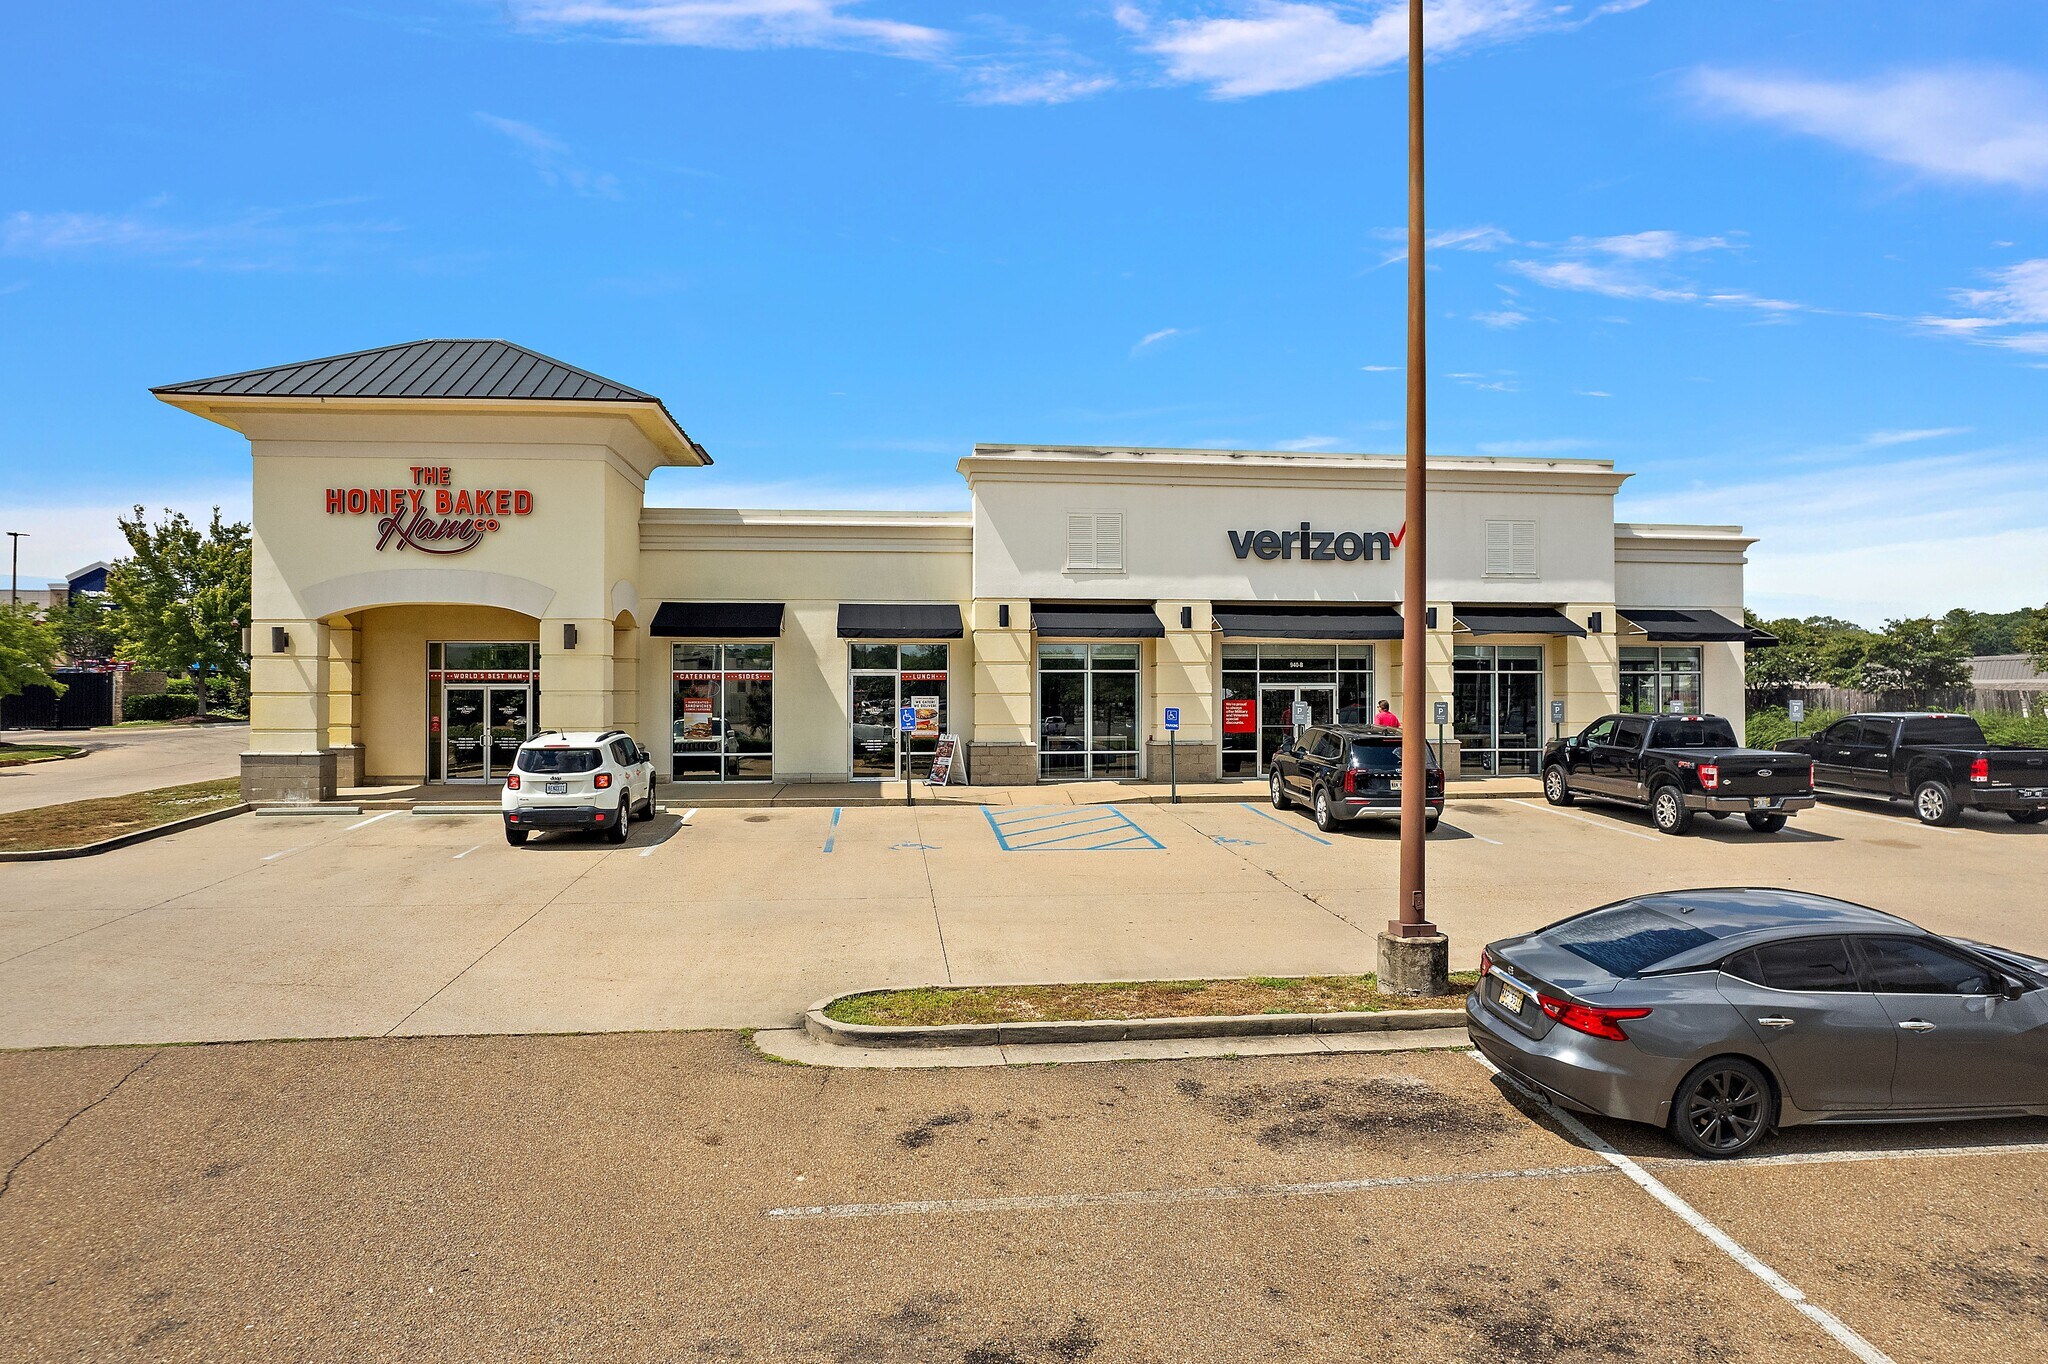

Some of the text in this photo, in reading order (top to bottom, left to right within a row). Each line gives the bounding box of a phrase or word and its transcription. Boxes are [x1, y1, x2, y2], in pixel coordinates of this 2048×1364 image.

[410, 466, 451, 485] THE
[325, 488, 534, 515] HONEY BAKED
[374, 505, 500, 554] Ham CO
[1227, 521, 1391, 561] verizon
